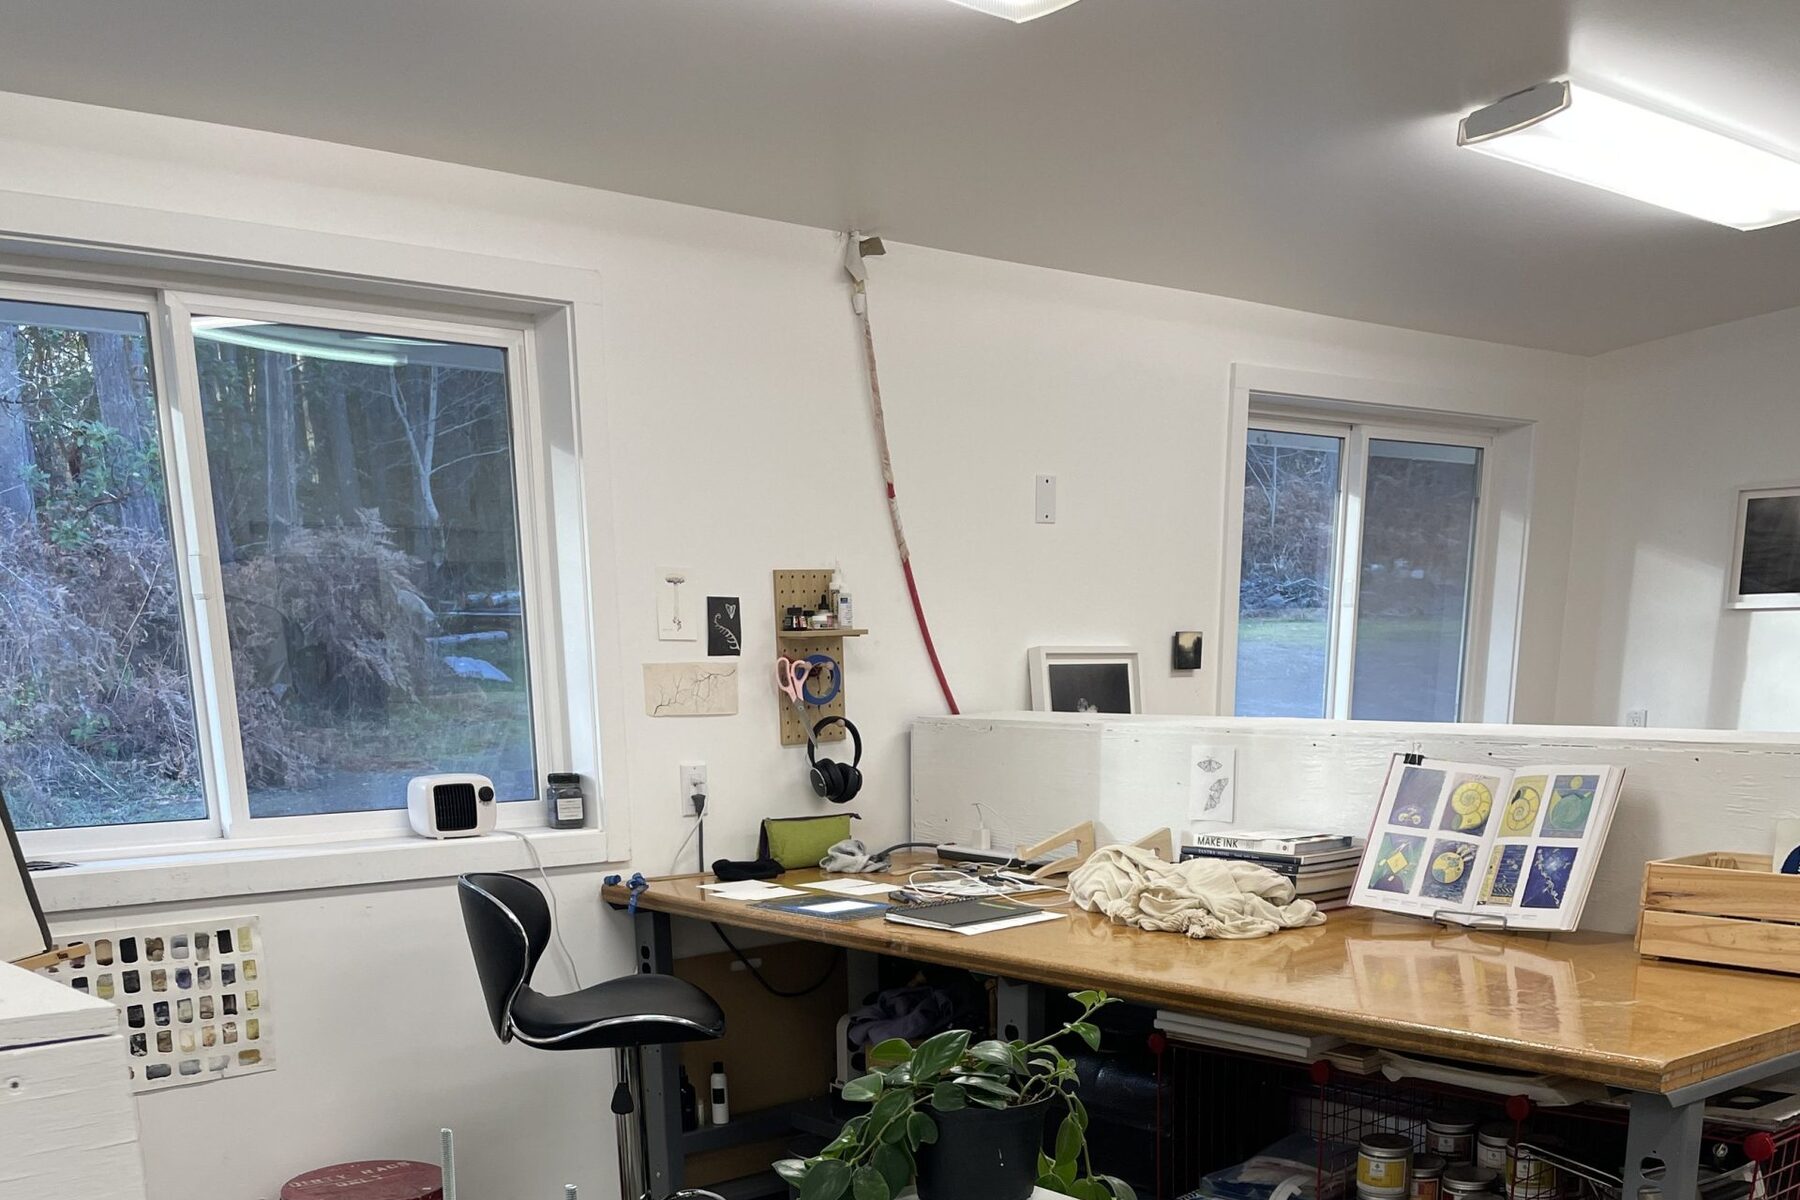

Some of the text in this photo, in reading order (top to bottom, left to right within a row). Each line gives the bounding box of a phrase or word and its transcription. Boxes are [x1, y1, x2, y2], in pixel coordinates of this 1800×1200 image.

[1197, 836, 1239, 849] MAKE INK
[288, 1161, 411, 1188] DIRTY RAGS
[335, 1175, 383, 1187] ONLY
